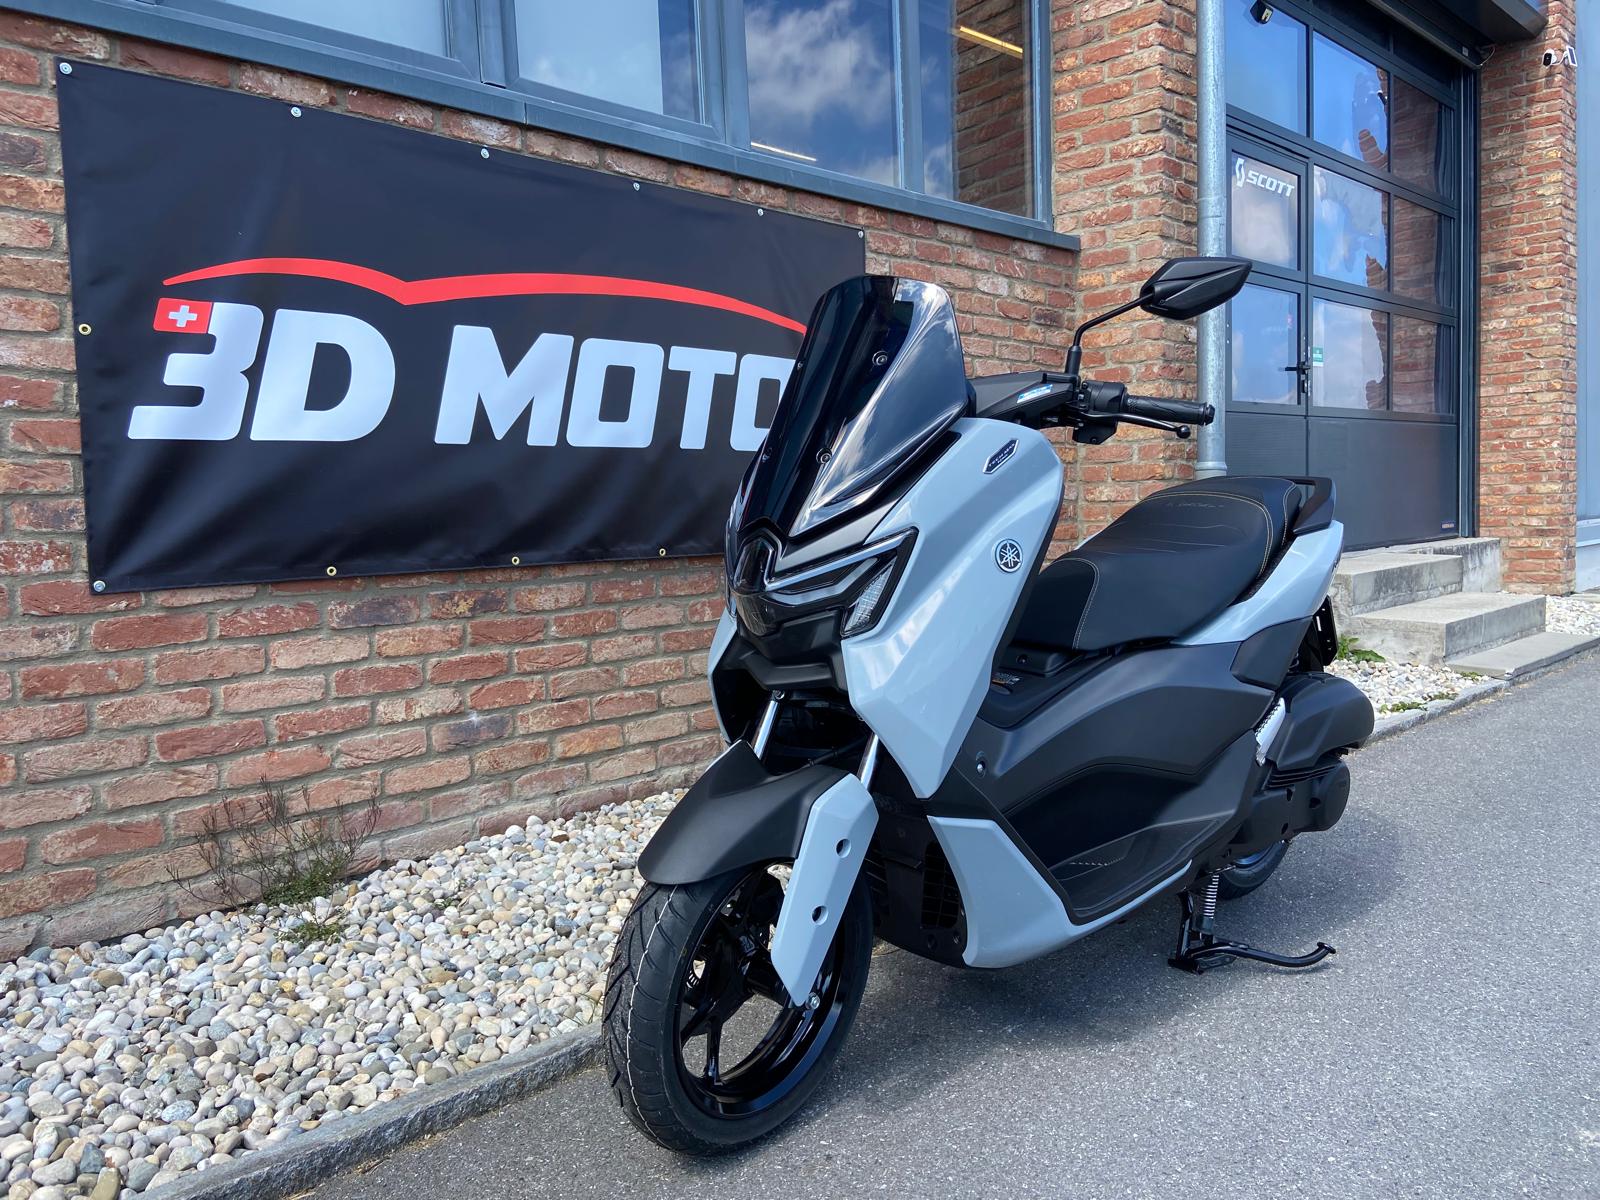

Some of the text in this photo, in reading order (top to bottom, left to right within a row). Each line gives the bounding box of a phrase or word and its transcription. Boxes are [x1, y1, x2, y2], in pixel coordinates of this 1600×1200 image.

[1246, 170, 1295, 197] SCOTT
[127, 297, 797, 452] 3D MOTO
